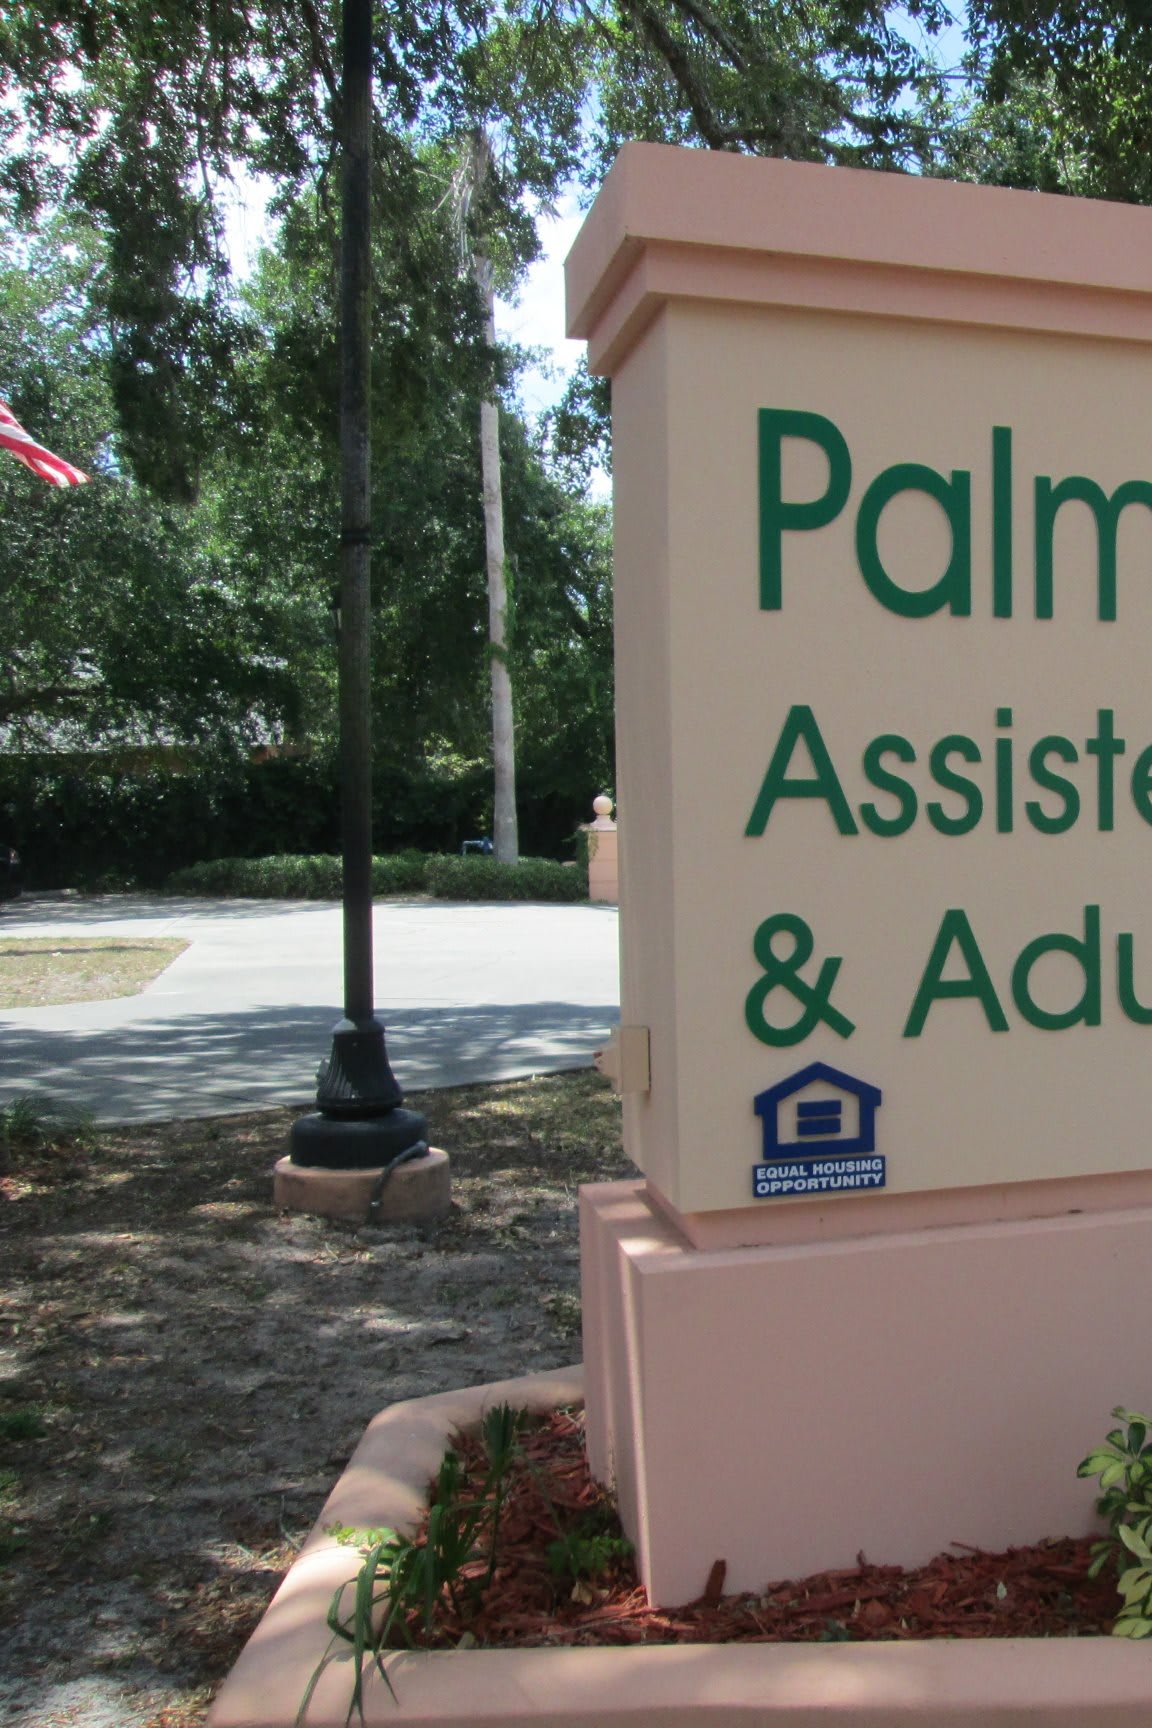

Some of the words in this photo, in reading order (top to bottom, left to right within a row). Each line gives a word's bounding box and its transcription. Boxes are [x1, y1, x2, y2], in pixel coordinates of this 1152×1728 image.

[744, 912, 856, 1046] &
[756, 1165, 808, 1180] EQUAL
[812, 1159, 882, 1175] HOUSING
[756, 1173, 882, 1194] OPPORTUNITY
